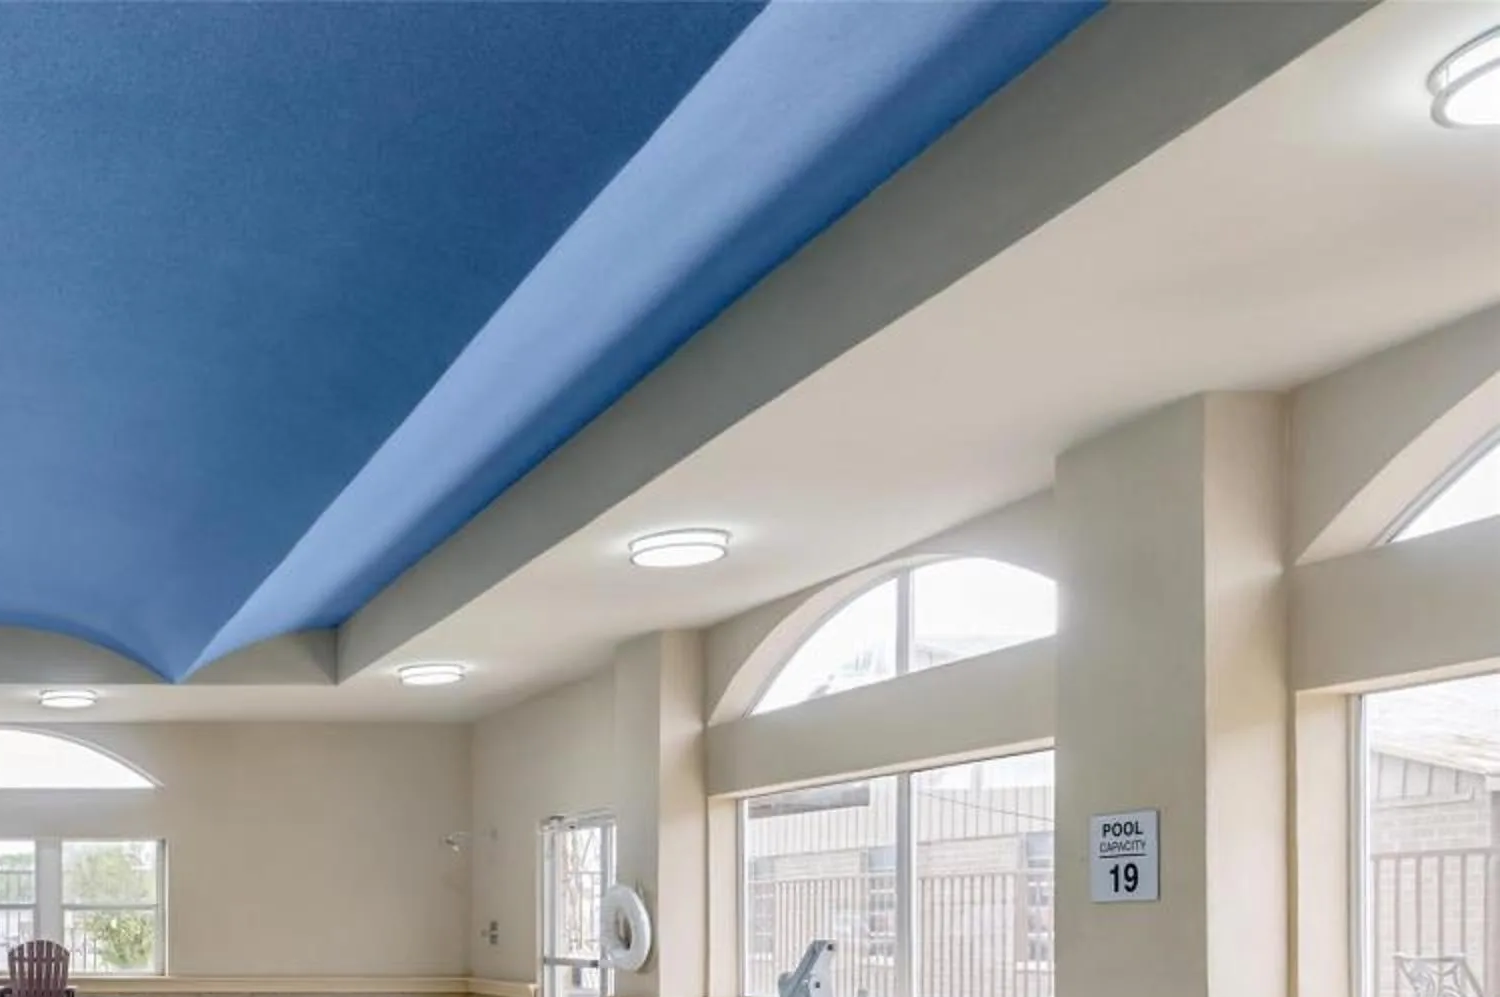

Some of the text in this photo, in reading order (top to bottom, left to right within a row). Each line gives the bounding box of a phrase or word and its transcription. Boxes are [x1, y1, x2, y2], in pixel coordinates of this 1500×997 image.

[1102, 821, 1144, 838] POOL
[1099, 840, 1147, 853] CAPACITY
[1109, 862, 1140, 893] 19
